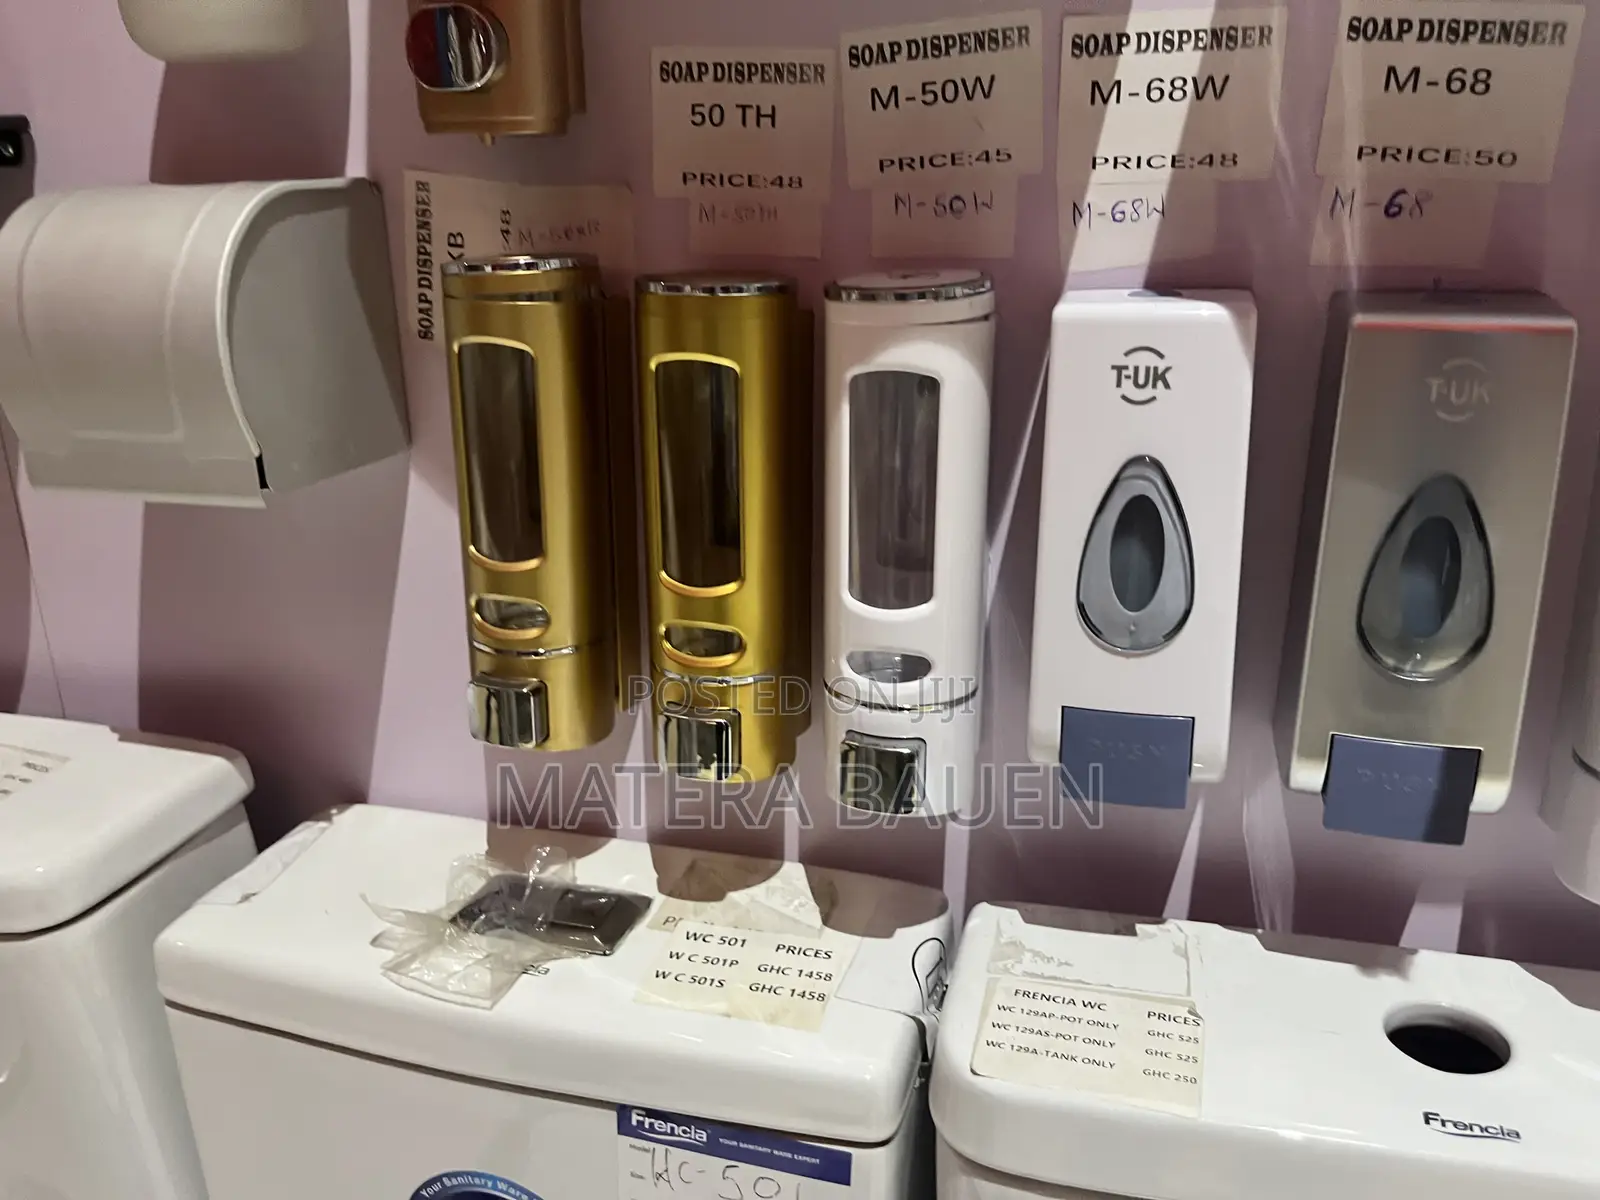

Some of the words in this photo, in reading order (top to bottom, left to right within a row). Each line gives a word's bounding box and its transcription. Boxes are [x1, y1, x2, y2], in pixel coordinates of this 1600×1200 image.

[1071, 32, 1131, 59] SOAP
[1134, 25, 1273, 55] DISPENSER
[1347, 16, 1413, 42] SOAP
[1416, 18, 1568, 46] DISPENSER
[849, 41, 902, 68] SOAP
[906, 25, 1030, 62] DISPENSER
[660, 61, 709, 83] SOAP
[712, 62, 825, 84] DISPENSER
[1383, 65, 1492, 96] M-68
[870, 74, 996, 112] M-50W
[1089, 74, 1230, 106] M-68W
[690, 103, 724, 128] 50
[735, 104, 777, 128] TH
[879, 149, 1012, 173] PRICE:45
[1091, 152, 1238, 171] PRICE:48
[1357, 145, 1518, 168] PRICE:50
[682, 171, 803, 189] PRICE:48
[1072, 194, 1165, 230] M-68W
[416, 180, 433, 291] DISPENSER
[418, 292, 434, 341] SOAP
[1111, 365, 1173, 391] T-UK
[1426, 376, 1491, 405] T-UK
[685, 931, 714, 944] WC
[717, 936, 747, 948] 501
[775, 944, 833, 960] PRICES
[702, 956, 739, 968] 501P
[757, 964, 792, 977] GHC
[797, 969, 833, 982] 1458
[688, 975, 726, 989] 501S
[749, 982, 785, 996] GHC
[789, 988, 826, 1003] 1458
[997, 1004, 1016, 1014] WC
[1086, 1018, 1119, 1030] ONLY
[1147, 1029, 1174, 1040] GHC
[1014, 988, 1077, 1007] FRENCIA
[1082, 999, 1107, 1012] WC
[1147, 1011, 1201, 1027] PRICES
[991, 1021, 1011, 1031] WC
[1082, 1037, 1116, 1049] ONLY
[1145, 1048, 1172, 1059] GHC
[986, 1040, 1006, 1050] WC
[1081, 1056, 1116, 1070] ONLY
[1142, 1068, 1171, 1080] GHC
[1173, 1074, 1198, 1085] 250
[630, 1109, 708, 1143] Frencia
[1422, 1111, 1522, 1140] Frencia
[420, 1182, 443, 1198] Your
[442, 1174, 493, 1188] Sanitary
